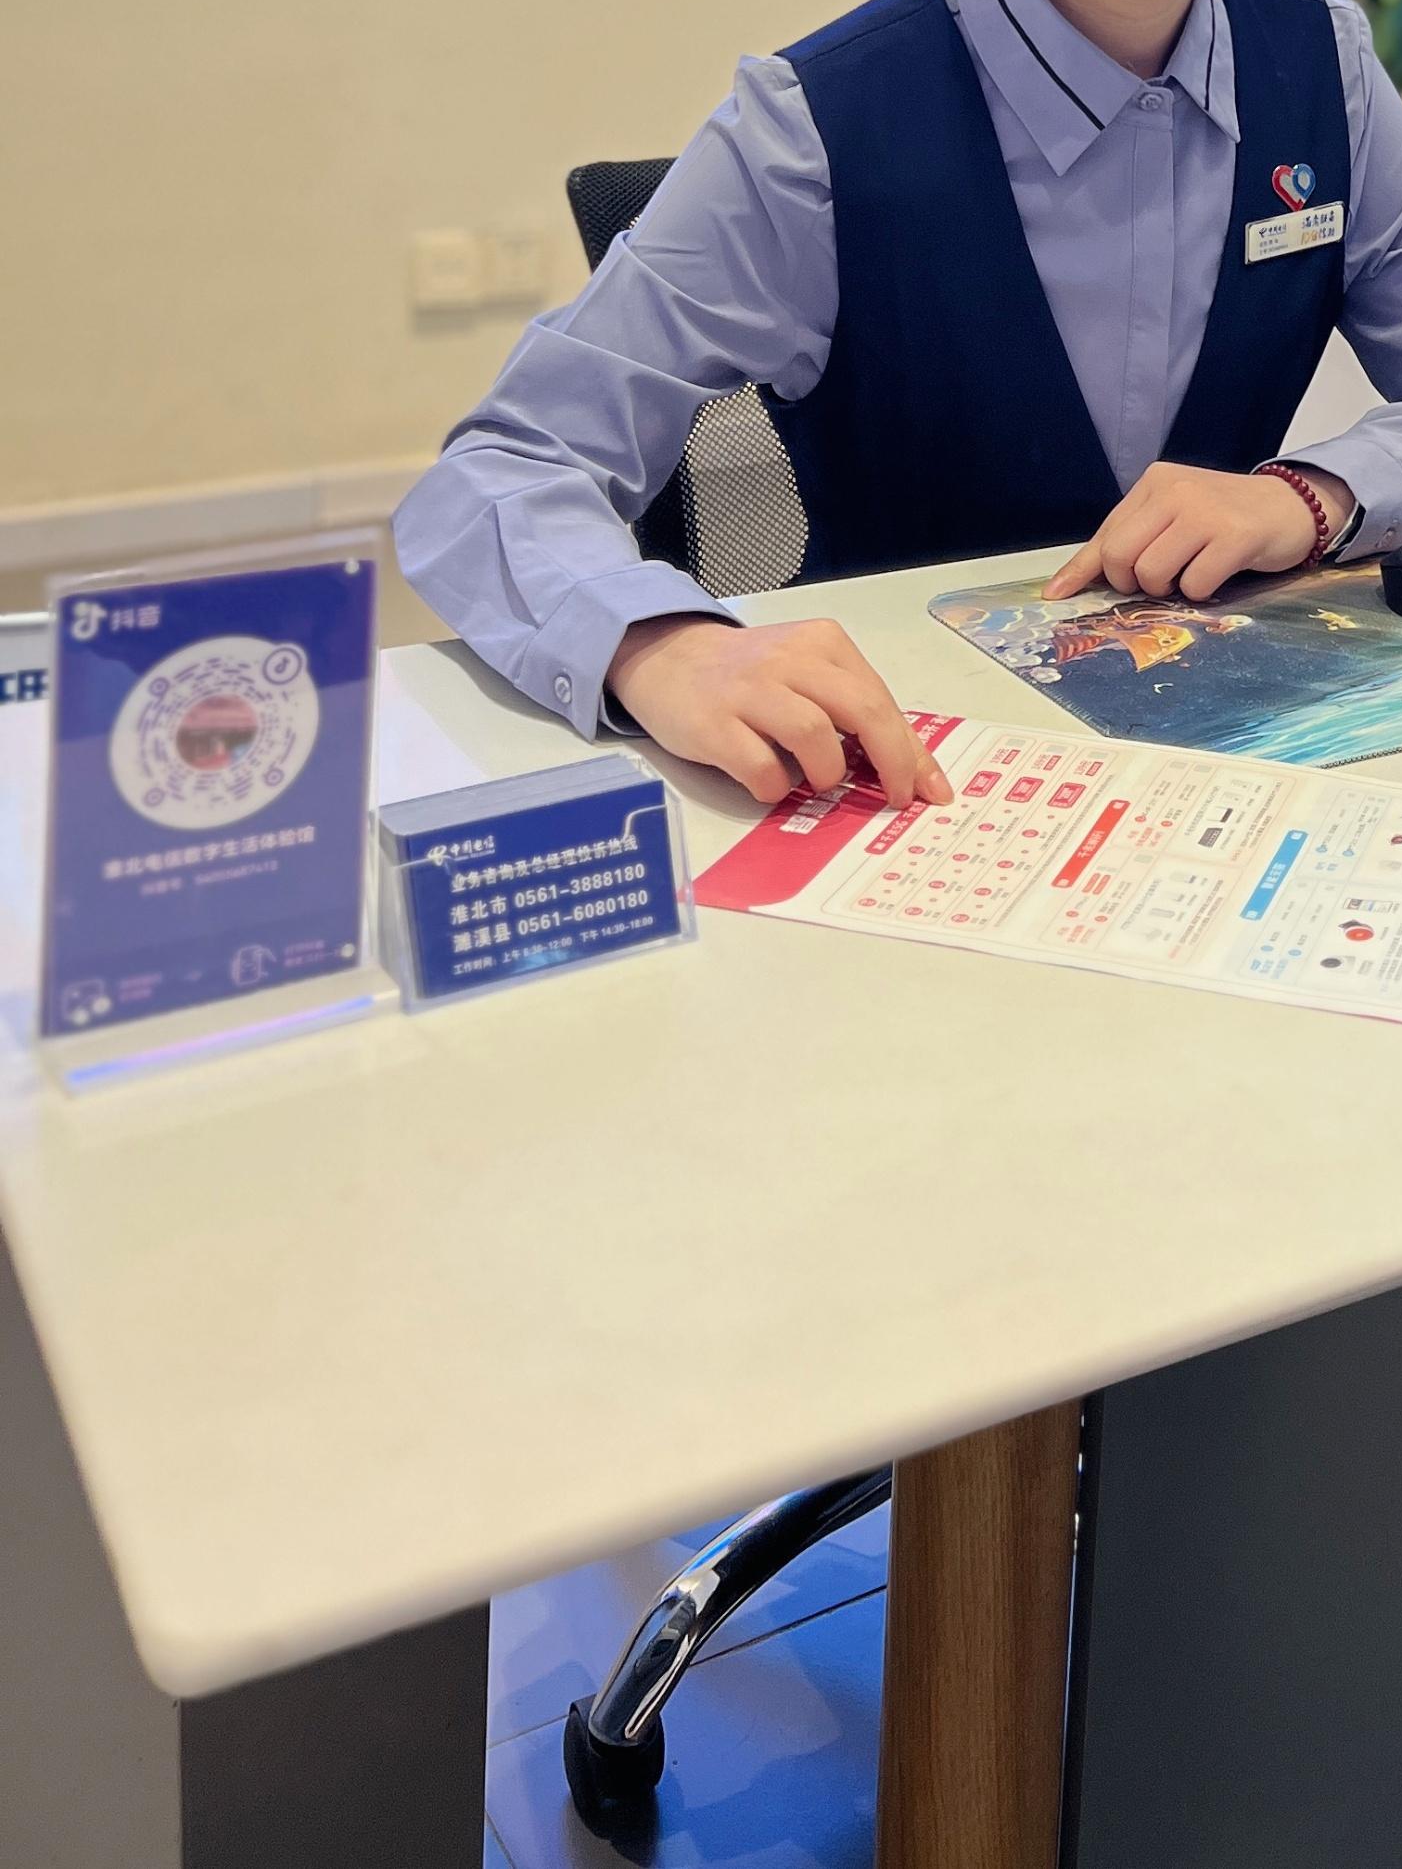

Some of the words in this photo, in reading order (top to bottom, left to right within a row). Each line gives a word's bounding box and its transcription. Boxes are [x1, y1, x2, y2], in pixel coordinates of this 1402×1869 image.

[110, 604, 161, 632] 抖音
[451, 896, 508, 925] 淮北市
[514, 863, 646, 908] 0561-3888180
[453, 922, 511, 953] 濉溪县
[518, 890, 649, 935] 0561-6080180
